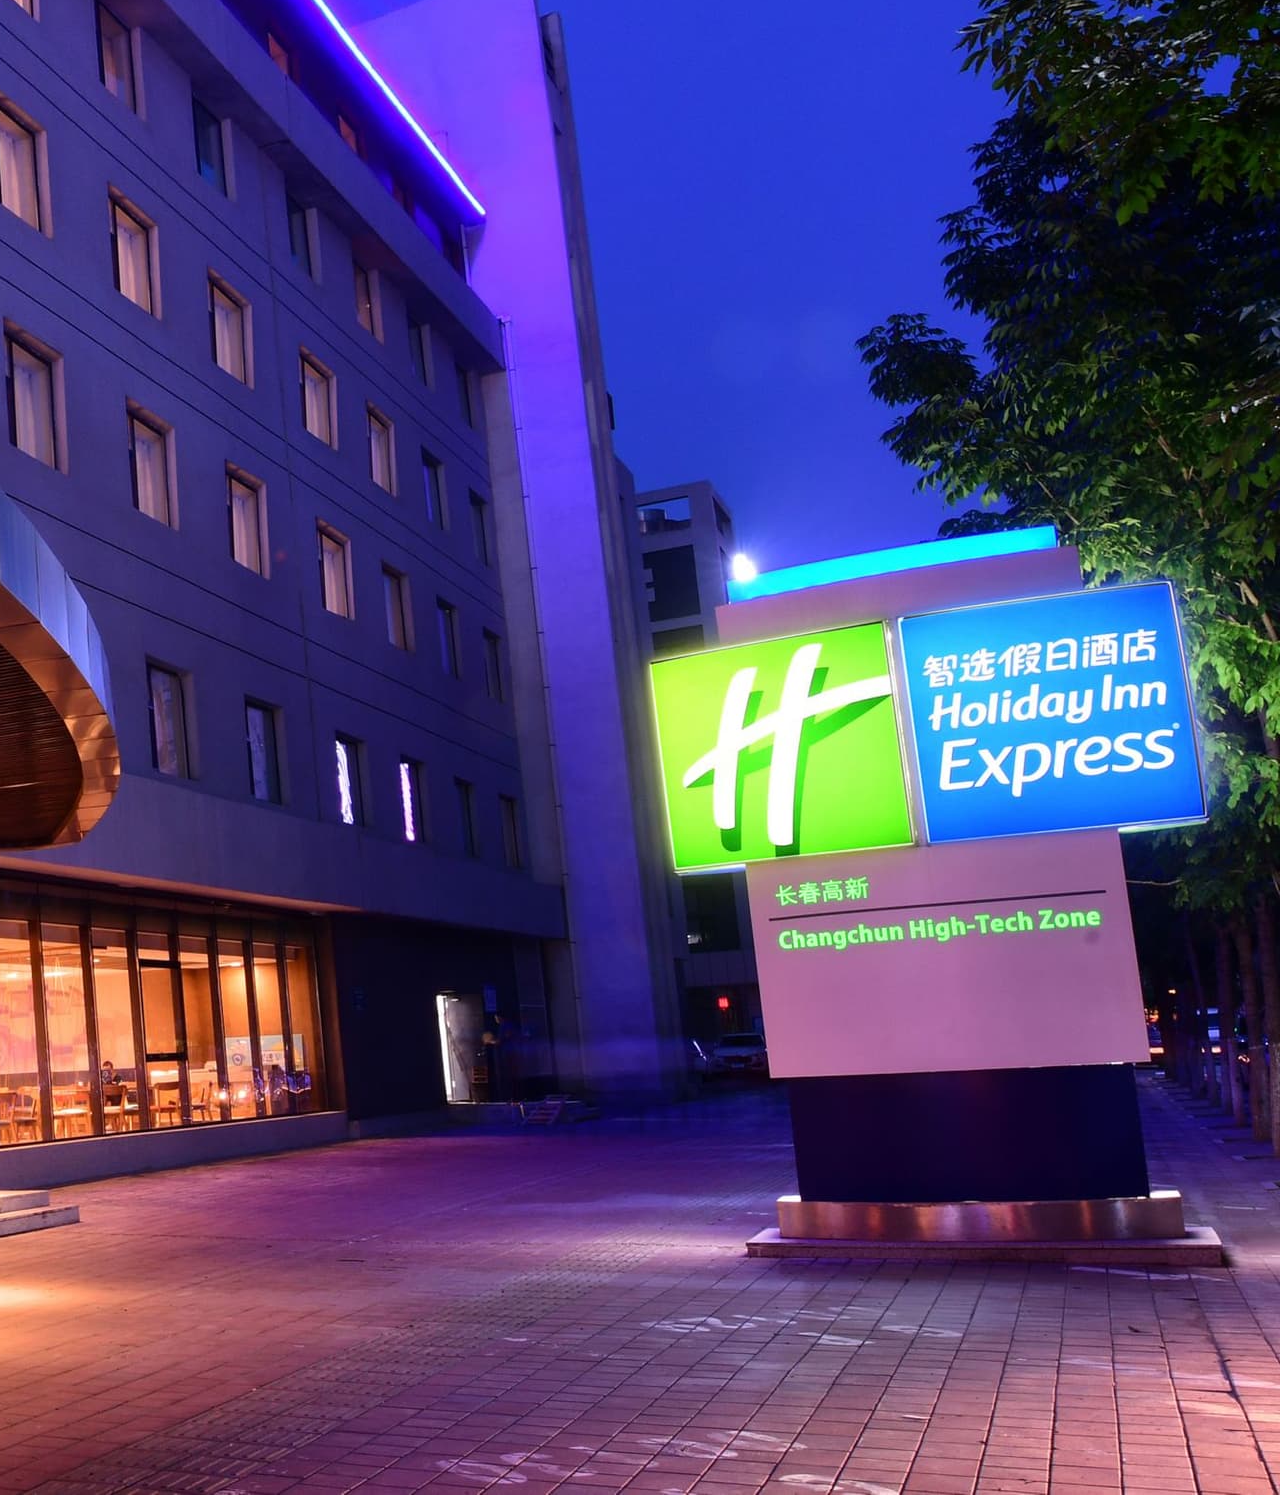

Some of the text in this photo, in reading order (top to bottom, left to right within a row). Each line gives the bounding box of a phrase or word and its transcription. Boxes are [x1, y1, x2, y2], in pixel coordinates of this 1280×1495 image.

[923, 629, 1157, 688] 智选假日酒店
[928, 674, 1167, 731] Holiday Inn
[939, 728, 1176, 798] Express
[775, 876, 869, 907] 长春高新
[778, 908, 1102, 950] Changchun High-Tech Zone
